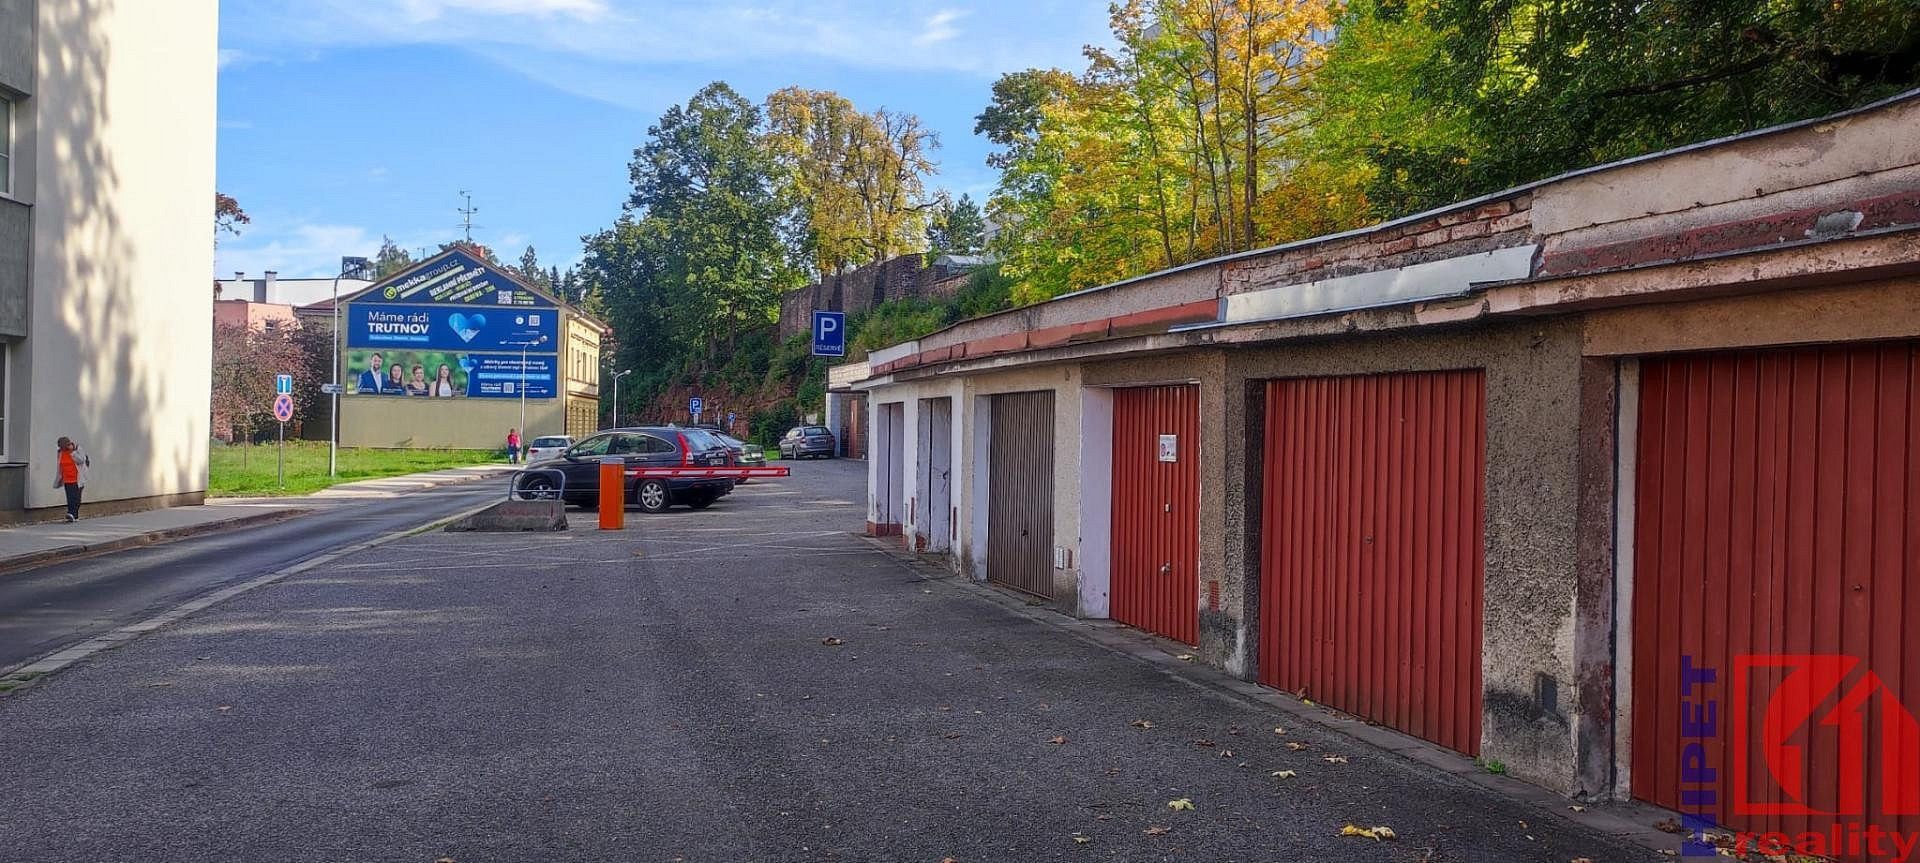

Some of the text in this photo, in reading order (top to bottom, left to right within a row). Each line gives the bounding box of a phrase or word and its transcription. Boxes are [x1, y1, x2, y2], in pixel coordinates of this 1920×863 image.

[396, 259, 458, 293] mekkagroup.cz
[368, 311, 430, 323] Máme rádi
[368, 322, 430, 335] TRUTNOV
[820, 317, 837, 341] P
[692, 400, 700, 412] P
